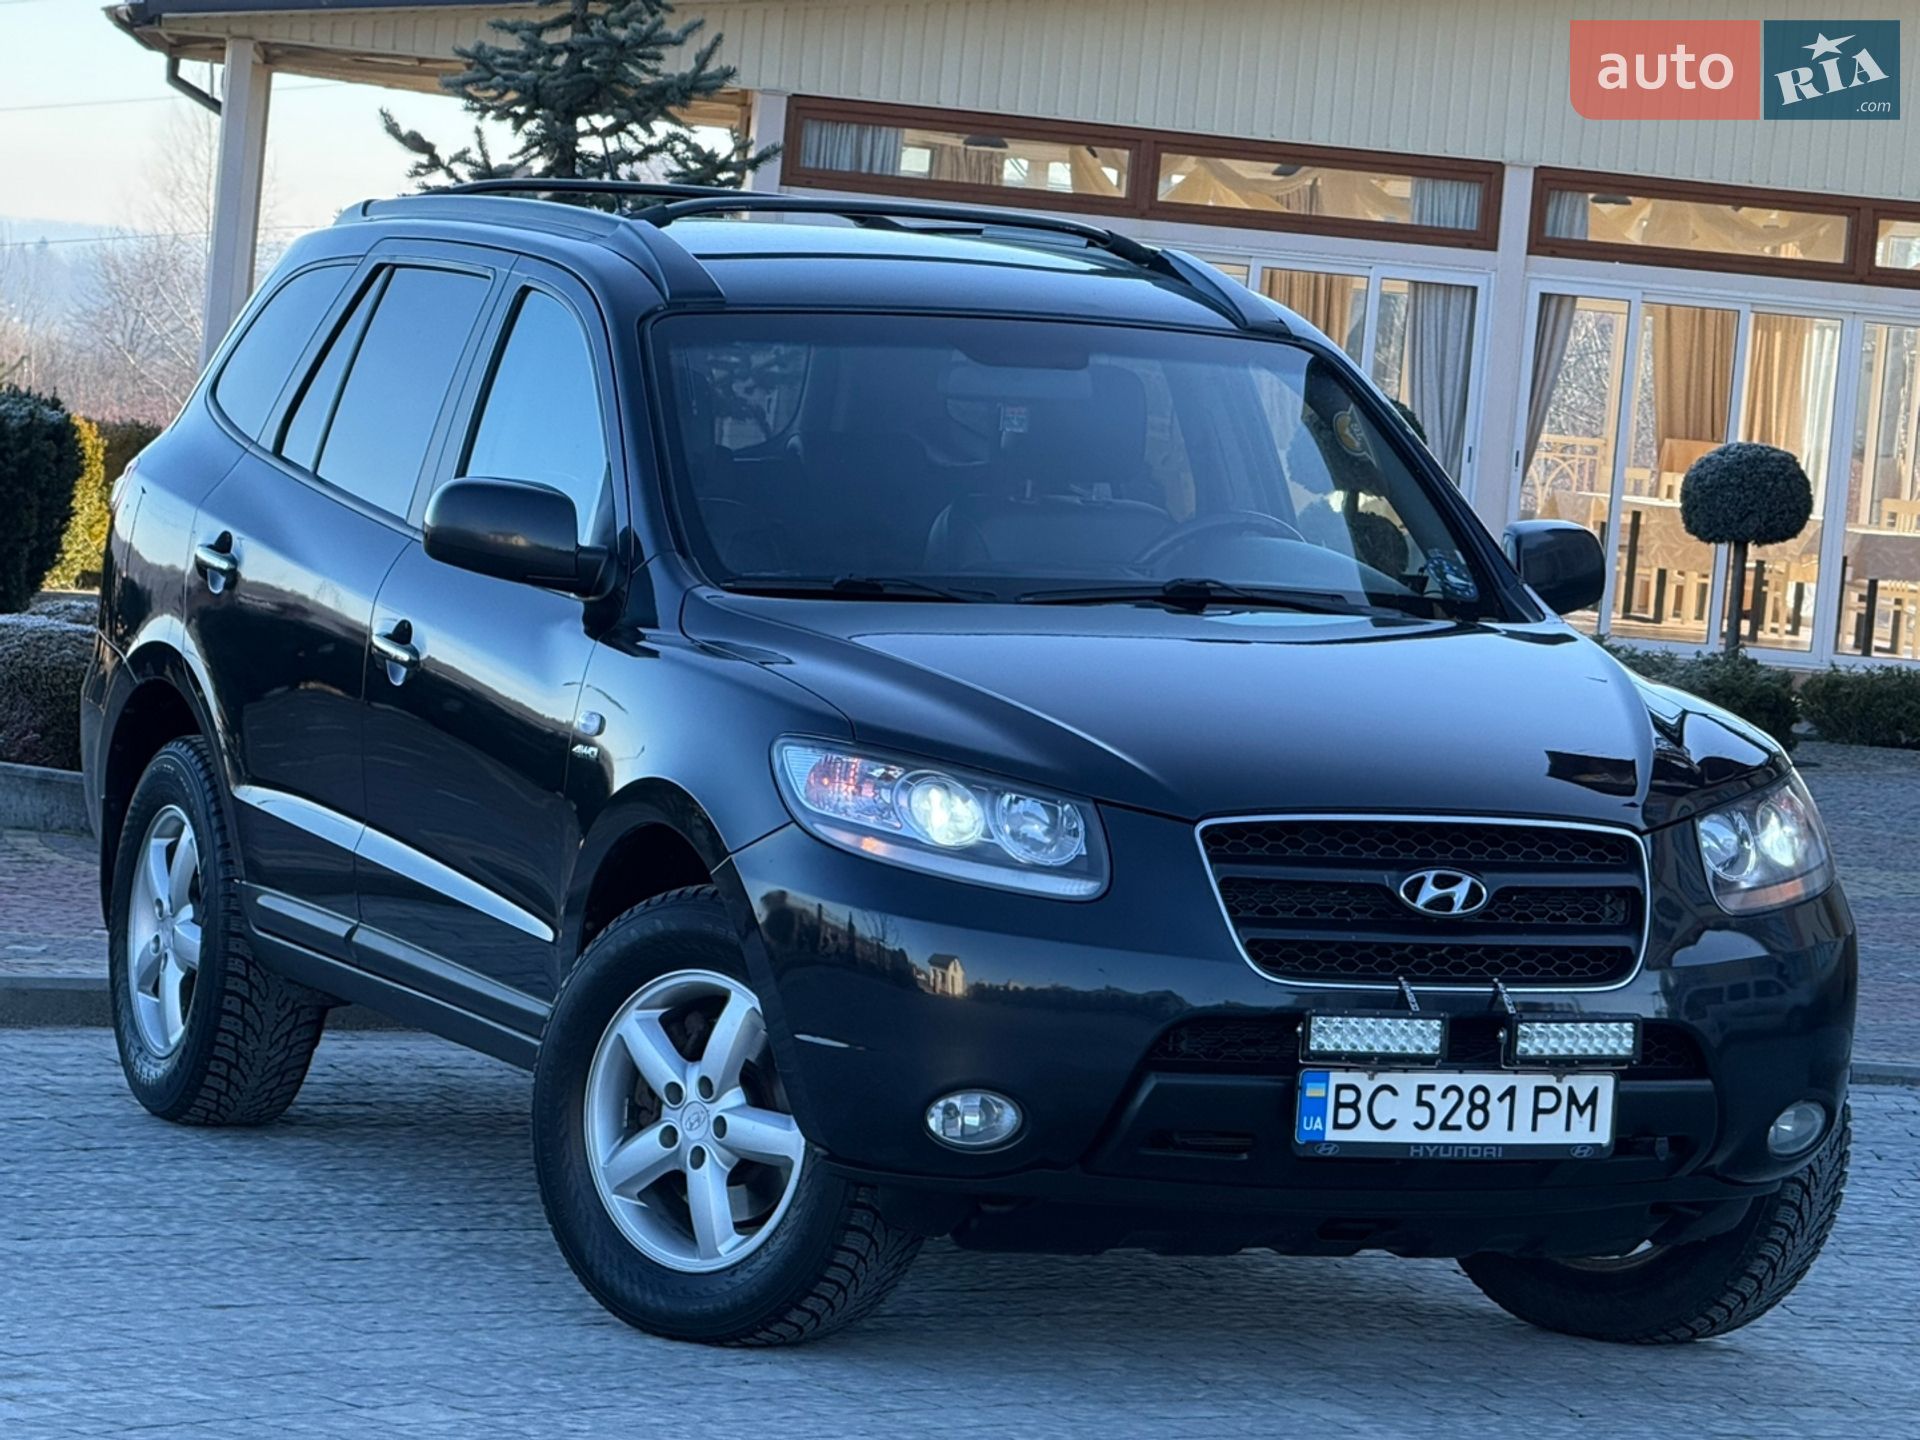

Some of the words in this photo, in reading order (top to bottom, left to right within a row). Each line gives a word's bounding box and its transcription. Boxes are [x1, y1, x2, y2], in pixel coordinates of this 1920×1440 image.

[1332, 1083, 1399, 1131] BC
[1413, 1084, 1517, 1132] 5281
[1530, 1085, 1599, 1132] PM
[1303, 1116, 1324, 1131] UA
[1409, 1144, 1503, 1159] HYUNDAI
